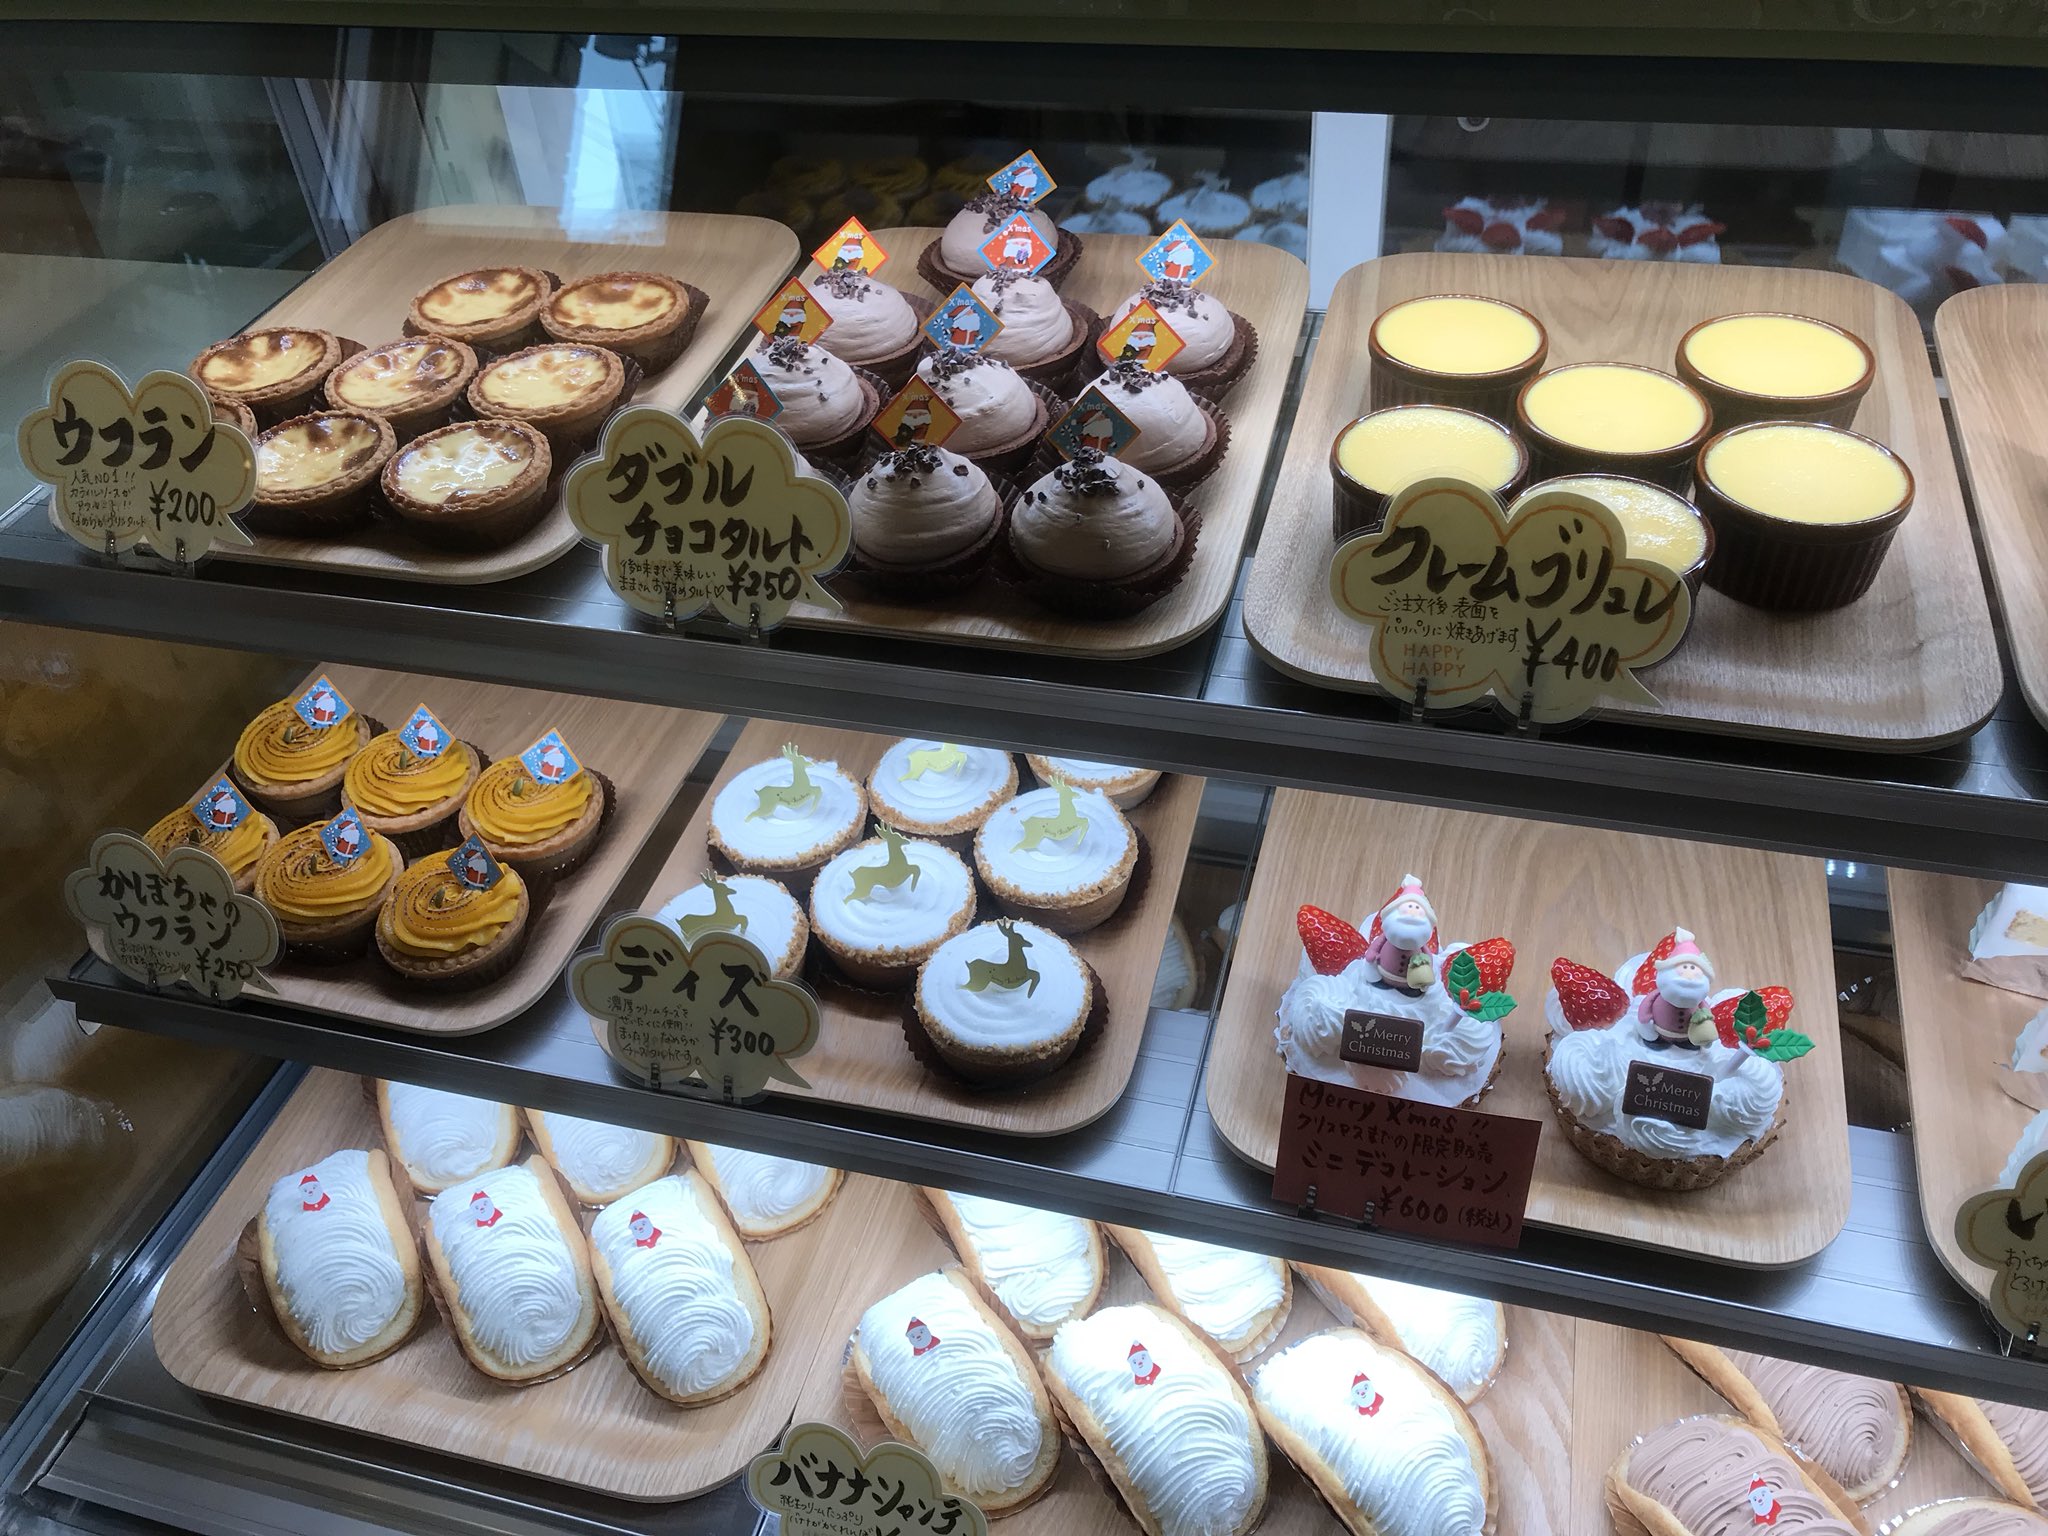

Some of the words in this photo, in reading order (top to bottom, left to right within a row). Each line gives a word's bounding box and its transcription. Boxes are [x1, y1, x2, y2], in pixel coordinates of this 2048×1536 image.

[839, 231, 864, 239] X'mas
[1007, 224, 1032, 233] X'mas
[1165, 232, 1192, 242] X'mas
[781, 293, 806, 302] X'mas
[949, 297, 976, 306] X'mas
[1129, 314, 1156, 324] X'mas
[734, 373, 758, 384] X'mas
[1077, 402, 1107, 412] X'mas
[51, 397, 216, 473] ウフラン
[606, 441, 755, 507] ダブル
[619, 560, 716, 580] 後味まで美味しい
[1371, 518, 1682, 624] クレームブリュレ
[1403, 643, 1465, 660] HAPPY
[1521, 617, 1620, 687] ¥400
[1402, 662, 1466, 678] HAPPY
[98, 866, 240, 927] かぼちゃの
[113, 903, 231, 950] ウフラン
[709, 1016, 775, 1056] ¥300
[1373, 1028, 1412, 1046] Merry
[1348, 1040, 1411, 1060] Christmas
[1660, 1082, 1701, 1103] Merry
[1300, 1082, 1375, 1122] Merry
[1387, 1101, 1458, 1134] X'mas
[1634, 1094, 1700, 1117] Christmas
[1377, 1184, 1448, 1224] ¥600
[769, 1452, 964, 1535] バナナシャンテ
